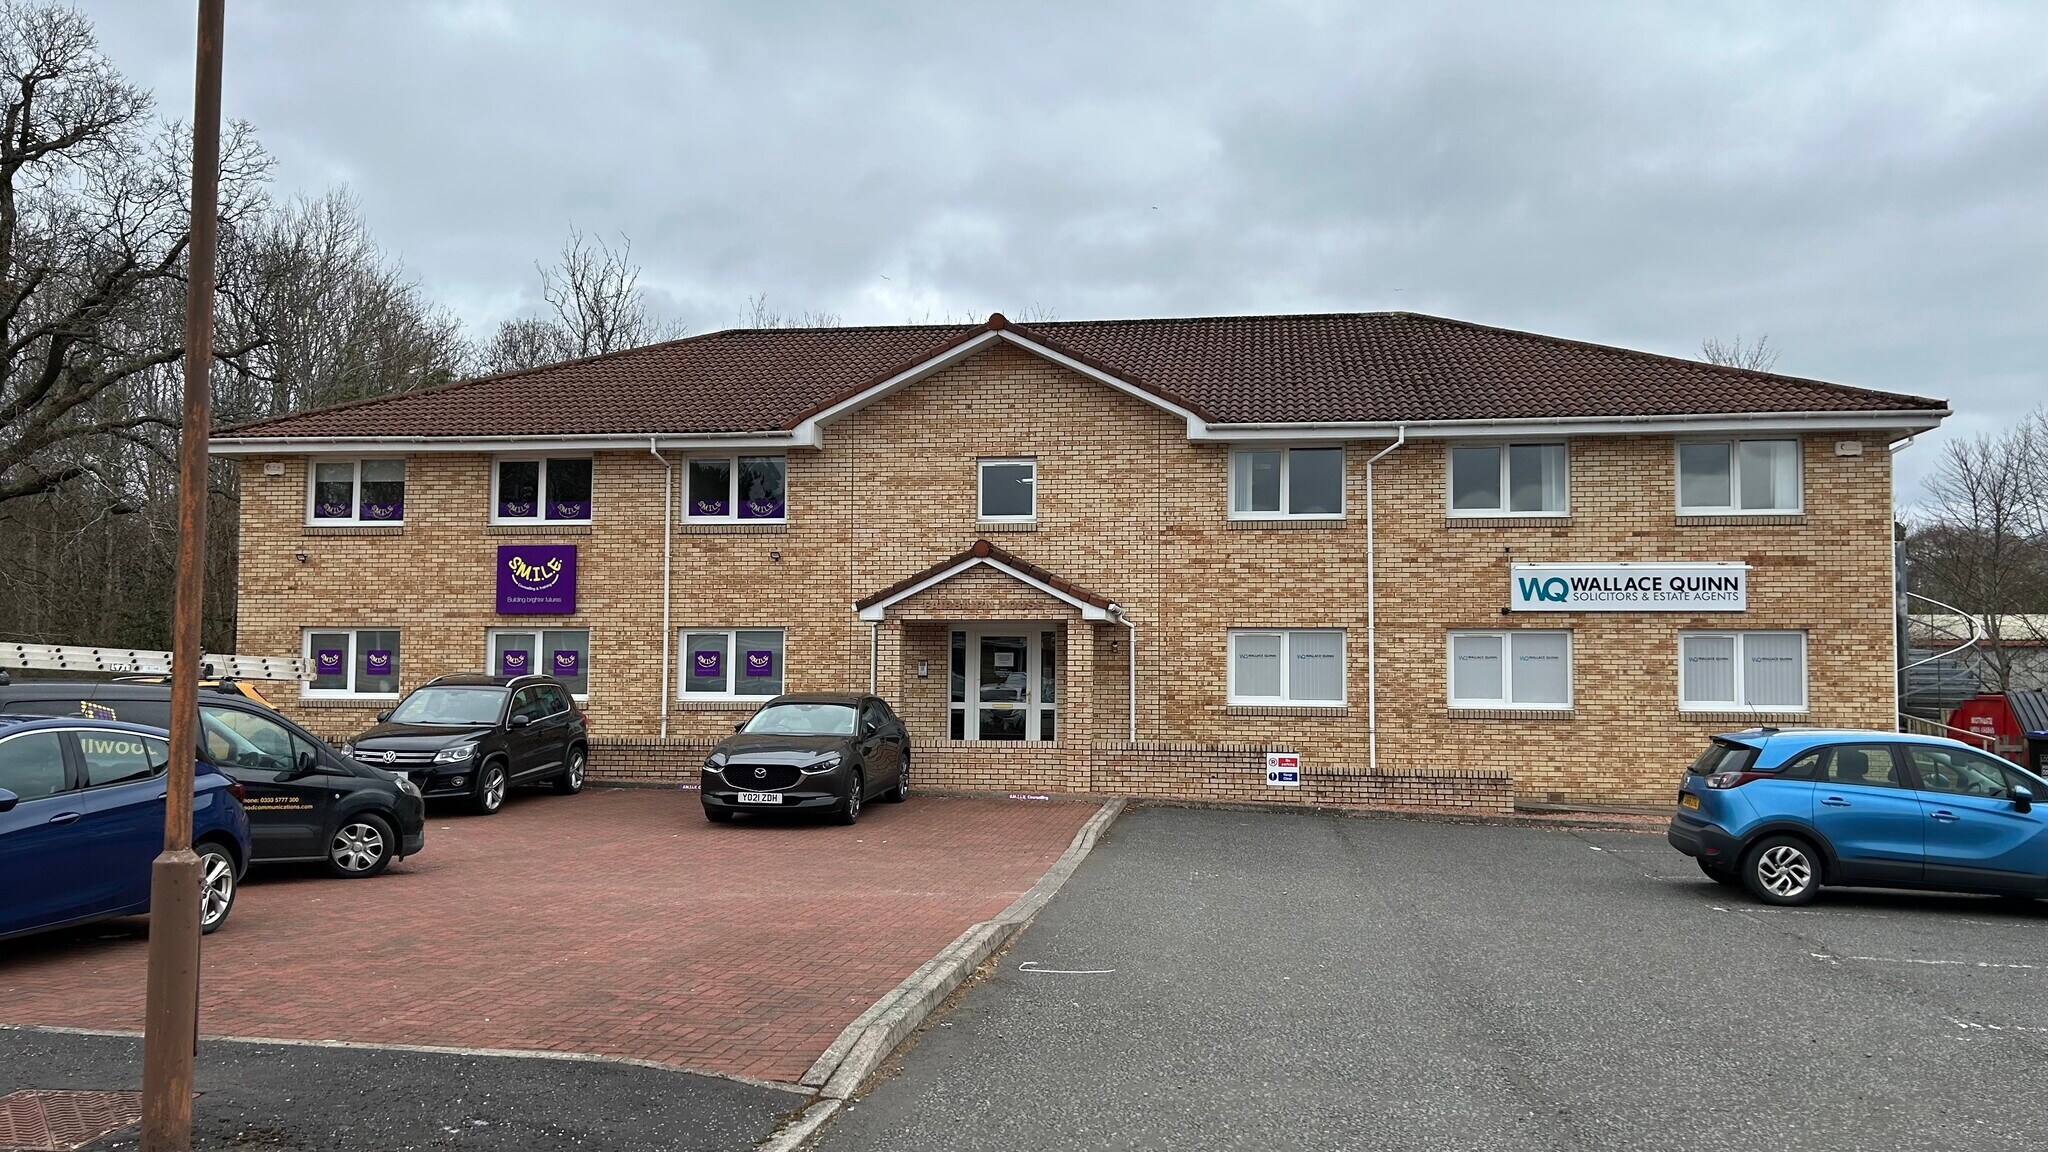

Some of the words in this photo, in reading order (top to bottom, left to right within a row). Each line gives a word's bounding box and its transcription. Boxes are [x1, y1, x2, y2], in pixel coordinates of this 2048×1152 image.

[1518, 576, 1568, 602] WQ
[1570, 577, 1662, 591] WALLACE
[1670, 577, 1738, 592] QUINN
[1573, 592, 1638, 600] SOLICITORS
[1642, 592, 1650, 600] &
[1653, 592, 1690, 600] ESTATE
[1694, 592, 1738, 600] AGENTS
